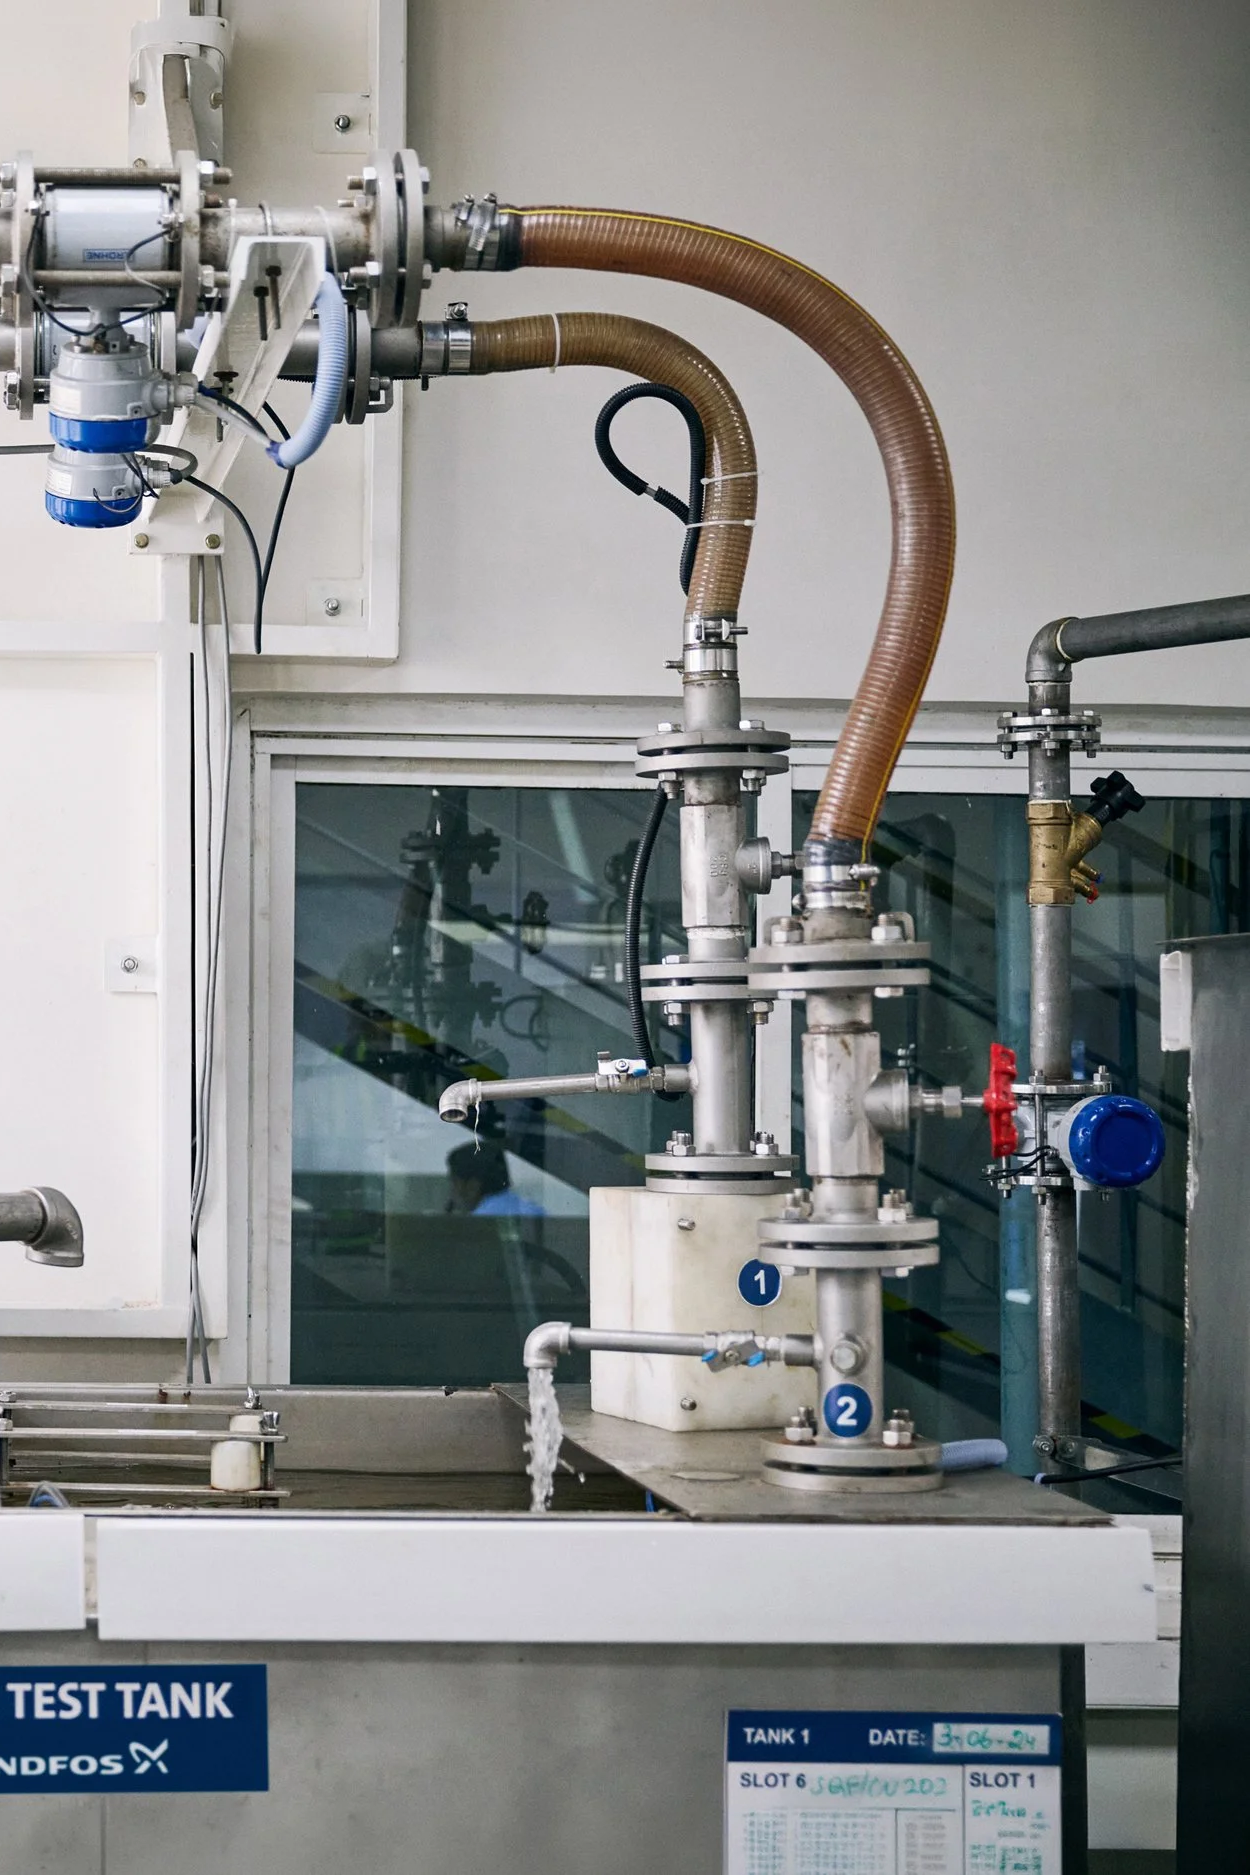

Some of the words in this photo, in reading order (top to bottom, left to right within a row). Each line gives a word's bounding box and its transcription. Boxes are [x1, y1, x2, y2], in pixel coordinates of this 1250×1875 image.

[86, 251, 128, 260] ROHNE
[754, 1269, 766, 1295] 1
[836, 1395, 857, 1426] 2
[7, 1682, 107, 1720] TEST
[115, 1682, 234, 1719] TANK
[743, 1727, 795, 1745] TANK
[801, 1728, 810, 1745] 1
[868, 1728, 926, 1746] DATE:
[740, 1772, 790, 1788] SLOT
[796, 1772, 807, 1789] 6
[969, 1771, 1022, 1788] SLOT
[1027, 1773, 1036, 1789] 1
